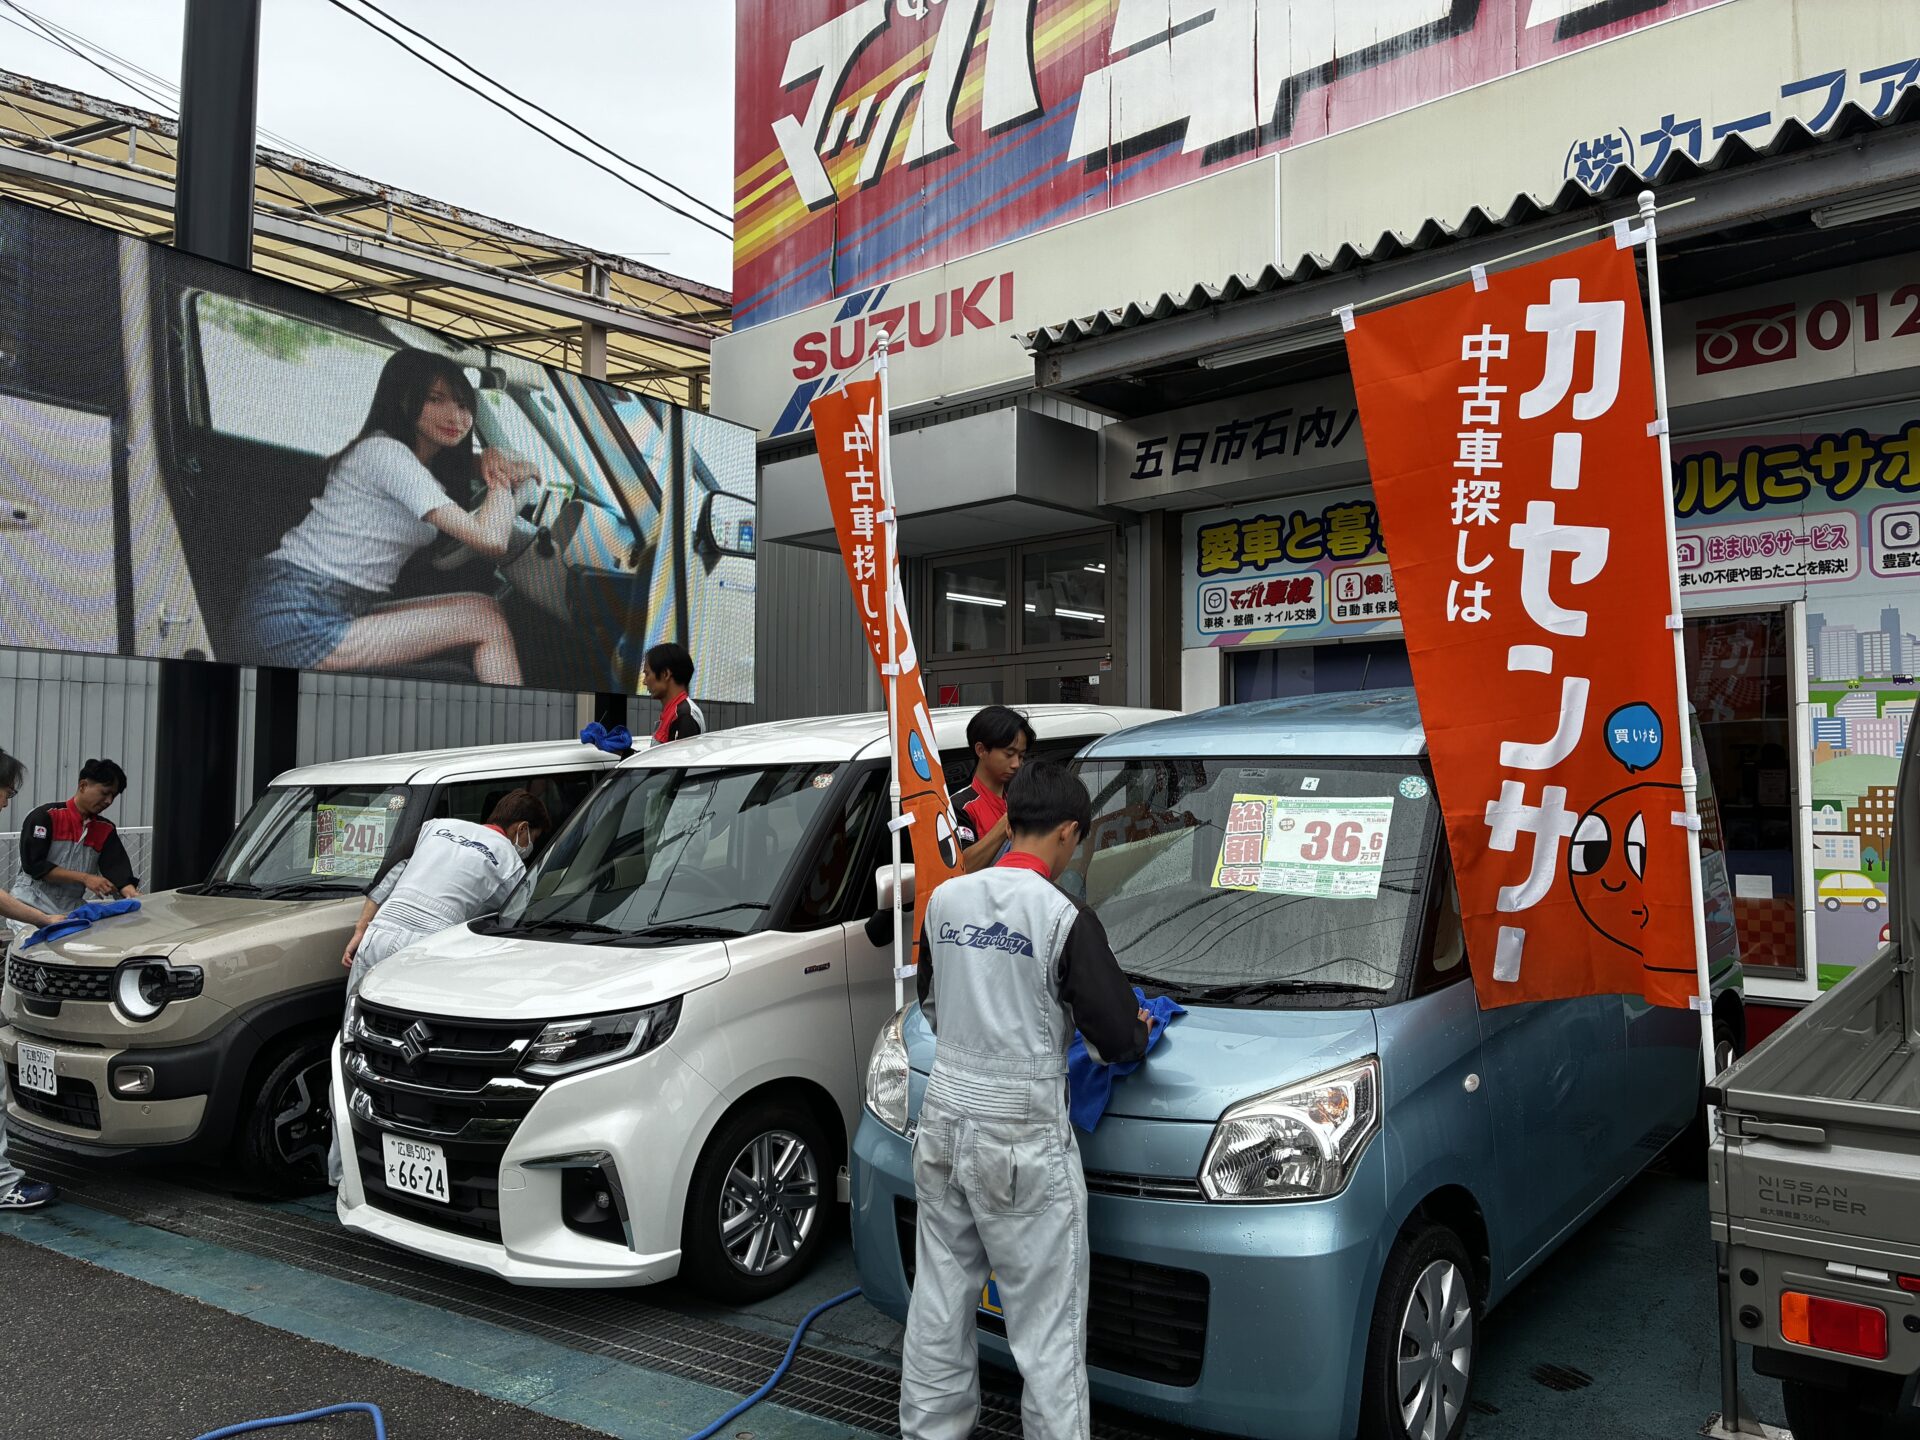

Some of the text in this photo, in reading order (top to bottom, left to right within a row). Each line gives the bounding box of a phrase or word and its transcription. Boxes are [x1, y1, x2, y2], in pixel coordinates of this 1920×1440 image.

[792, 271, 1014, 380] SUZUKI
[1447, 324, 1510, 622] 中古車探しは
[1199, 501, 1386, 577] 愛車と暮
[1707, 523, 1849, 564] 住まいるサービス
[1204, 608, 1317, 628] 車検・整備・オイル交換
[1484, 278, 1625, 983] カーセンサー
[940, 921, 1027, 954] Car Factory
[399, 1160, 445, 1197] 66-24
[1758, 1175, 1848, 1198] NISSAN
[1759, 1189, 1867, 1216] CLIPPER
